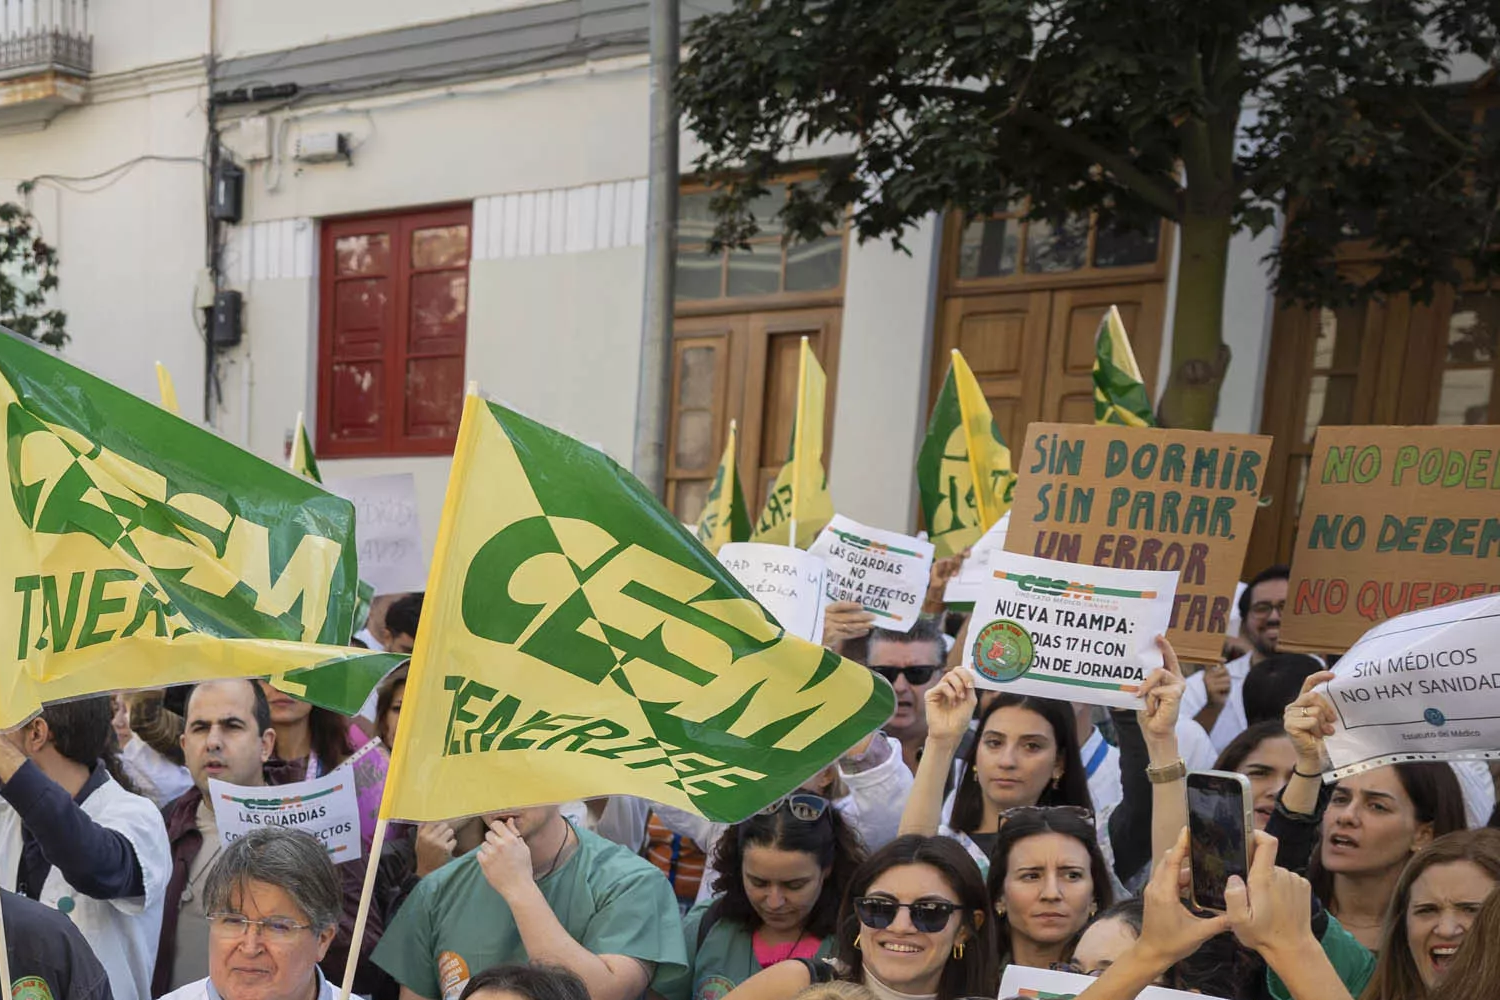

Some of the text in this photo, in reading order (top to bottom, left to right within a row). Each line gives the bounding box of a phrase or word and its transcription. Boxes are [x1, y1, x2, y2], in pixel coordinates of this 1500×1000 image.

[1030, 433, 1085, 476] SIN
[1321, 444, 1500, 490] NO PODE
[1033, 482, 1096, 524] SIN
[1307, 513, 1367, 551] NO
[763, 562, 798, 577] PARA
[829, 544, 904, 576] LAS GUARDIAS
[850, 566, 867, 580] NO
[1033, 530, 1082, 564] UN
[1092, 533, 1210, 586] ERROR
[826, 568, 918, 605] PUTAN A EFECTOS
[1293, 578, 1349, 616] NO
[461, 514, 875, 754] CESM
[994, 598, 1136, 636] NUEVA TRAMPA:
[1031, 631, 1127, 658] DIAS 17 H CON
[1353, 648, 1478, 678] SIN MÉDICOS
[1052, 657, 1073, 674] DE
[1074, 659, 1148, 682] JORNADA.
[1339, 672, 1500, 704] NO HAY SANIDAD
[238, 806, 327, 827] LAS GUARDIAS
